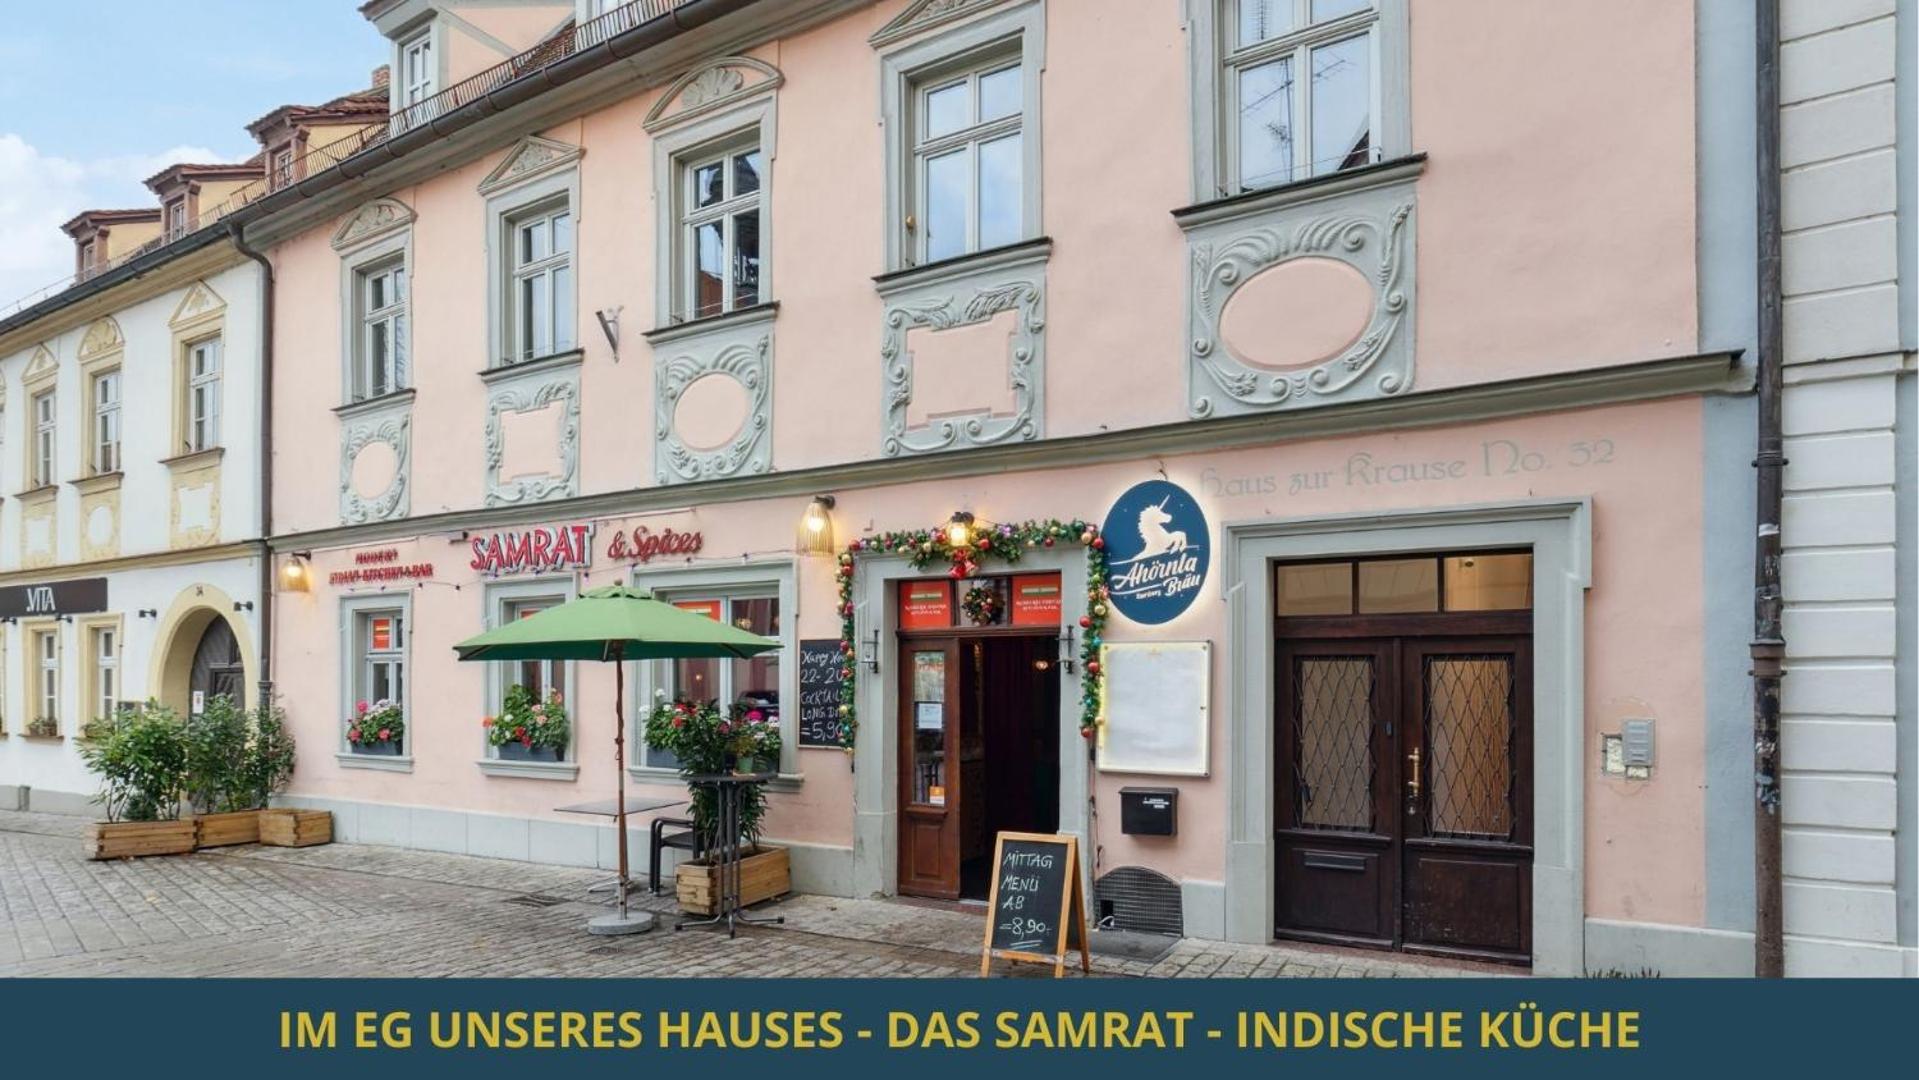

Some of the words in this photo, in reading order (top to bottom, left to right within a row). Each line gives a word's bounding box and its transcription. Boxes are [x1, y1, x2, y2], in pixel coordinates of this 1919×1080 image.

[1288, 471, 1335, 496] zur
[1346, 452, 1466, 486] Krause
[1481, 439, 1551, 477] No.
[1568, 439, 1615, 467] 32
[470, 522, 595, 572] SAMRAT
[608, 531, 627, 559] &
[629, 525, 703, 561] Spices
[1111, 553, 1198, 590] Ahörnla
[1163, 574, 1201, 597] Bräu
[1003, 851, 1053, 868] MITTAG
[1003, 895, 1024, 909] AB
